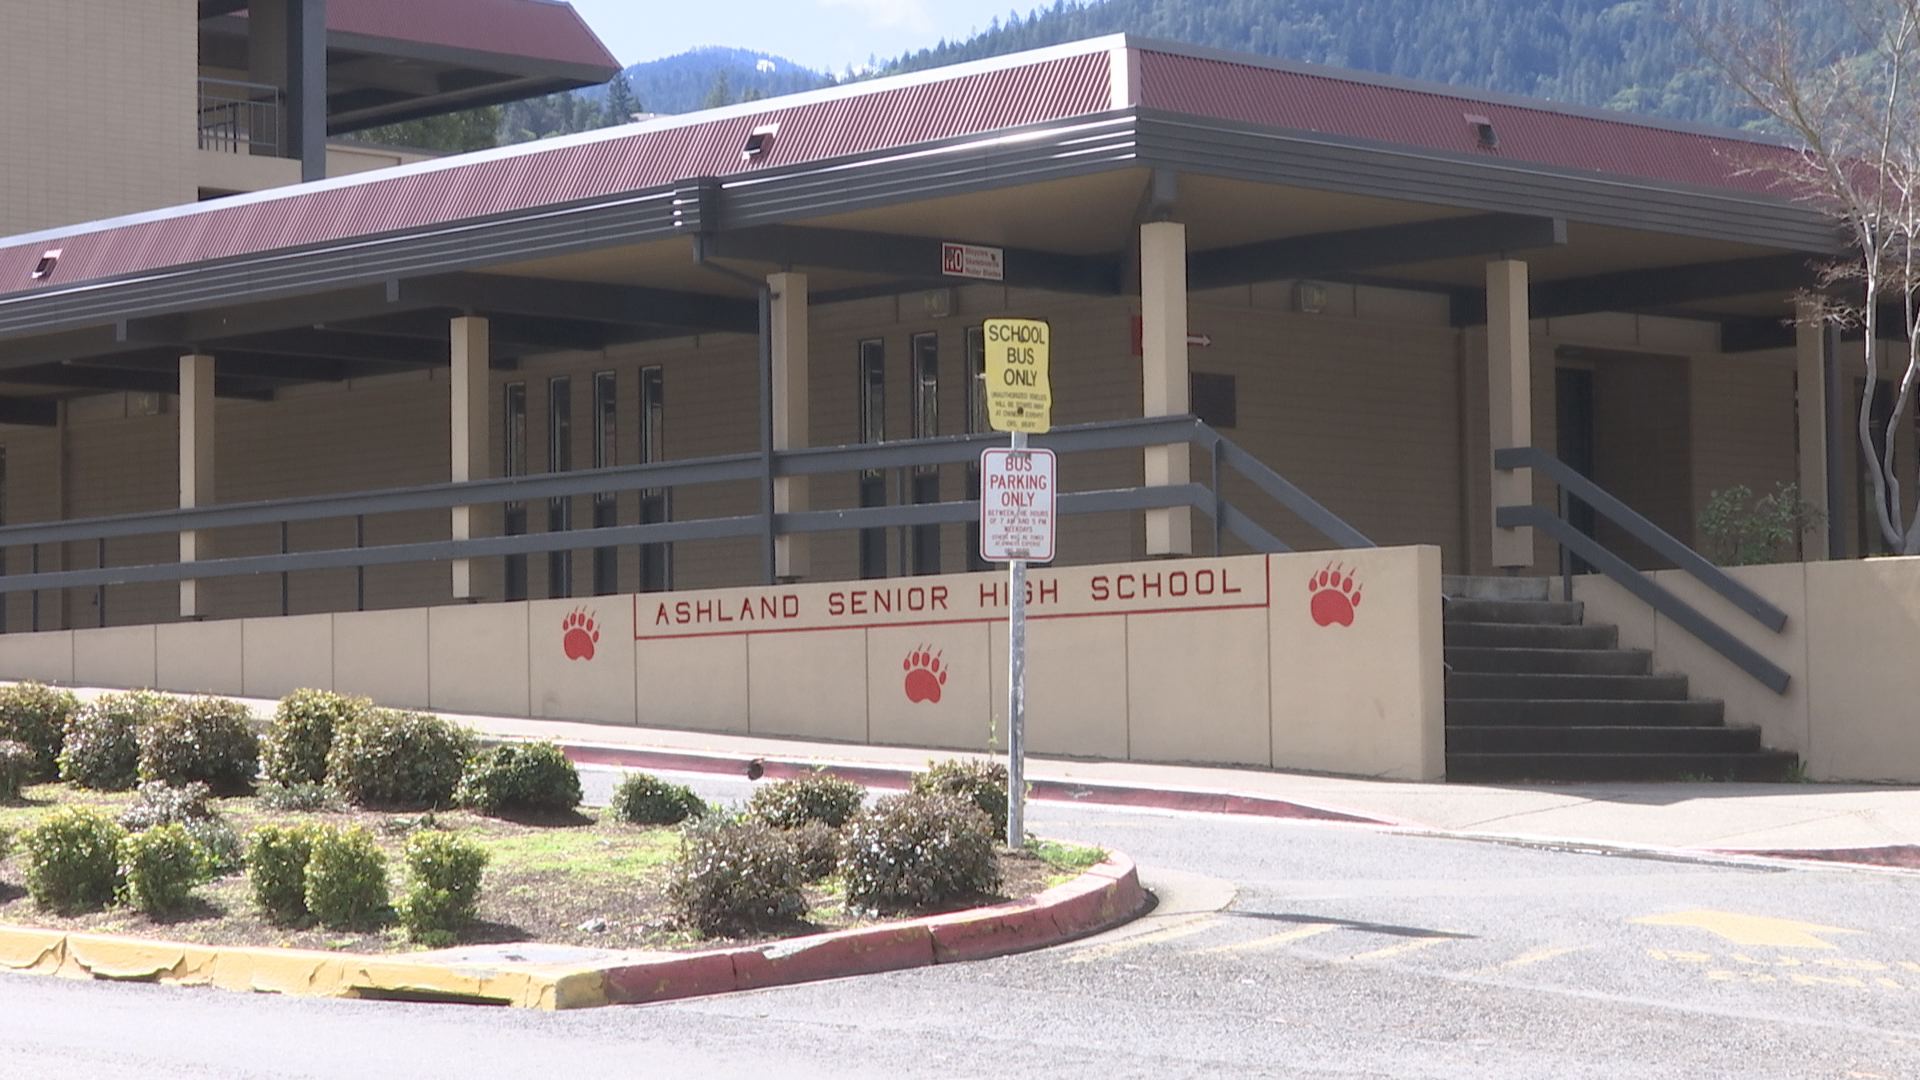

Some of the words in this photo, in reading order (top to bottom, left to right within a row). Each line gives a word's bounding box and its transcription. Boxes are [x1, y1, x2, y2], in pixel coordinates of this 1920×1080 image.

[988, 324, 1045, 345] SCHOOL
[1007, 347, 1035, 365] BUS
[1003, 368, 1037, 387] ONLY
[1005, 456, 1032, 471] BUS
[990, 474, 1047, 490] PARKING
[1001, 491, 1035, 507] ONLY
[655, 594, 800, 626] ASHLAND
[828, 585, 948, 616] SENIOR
[1091, 568, 1242, 601] SCHOOL
